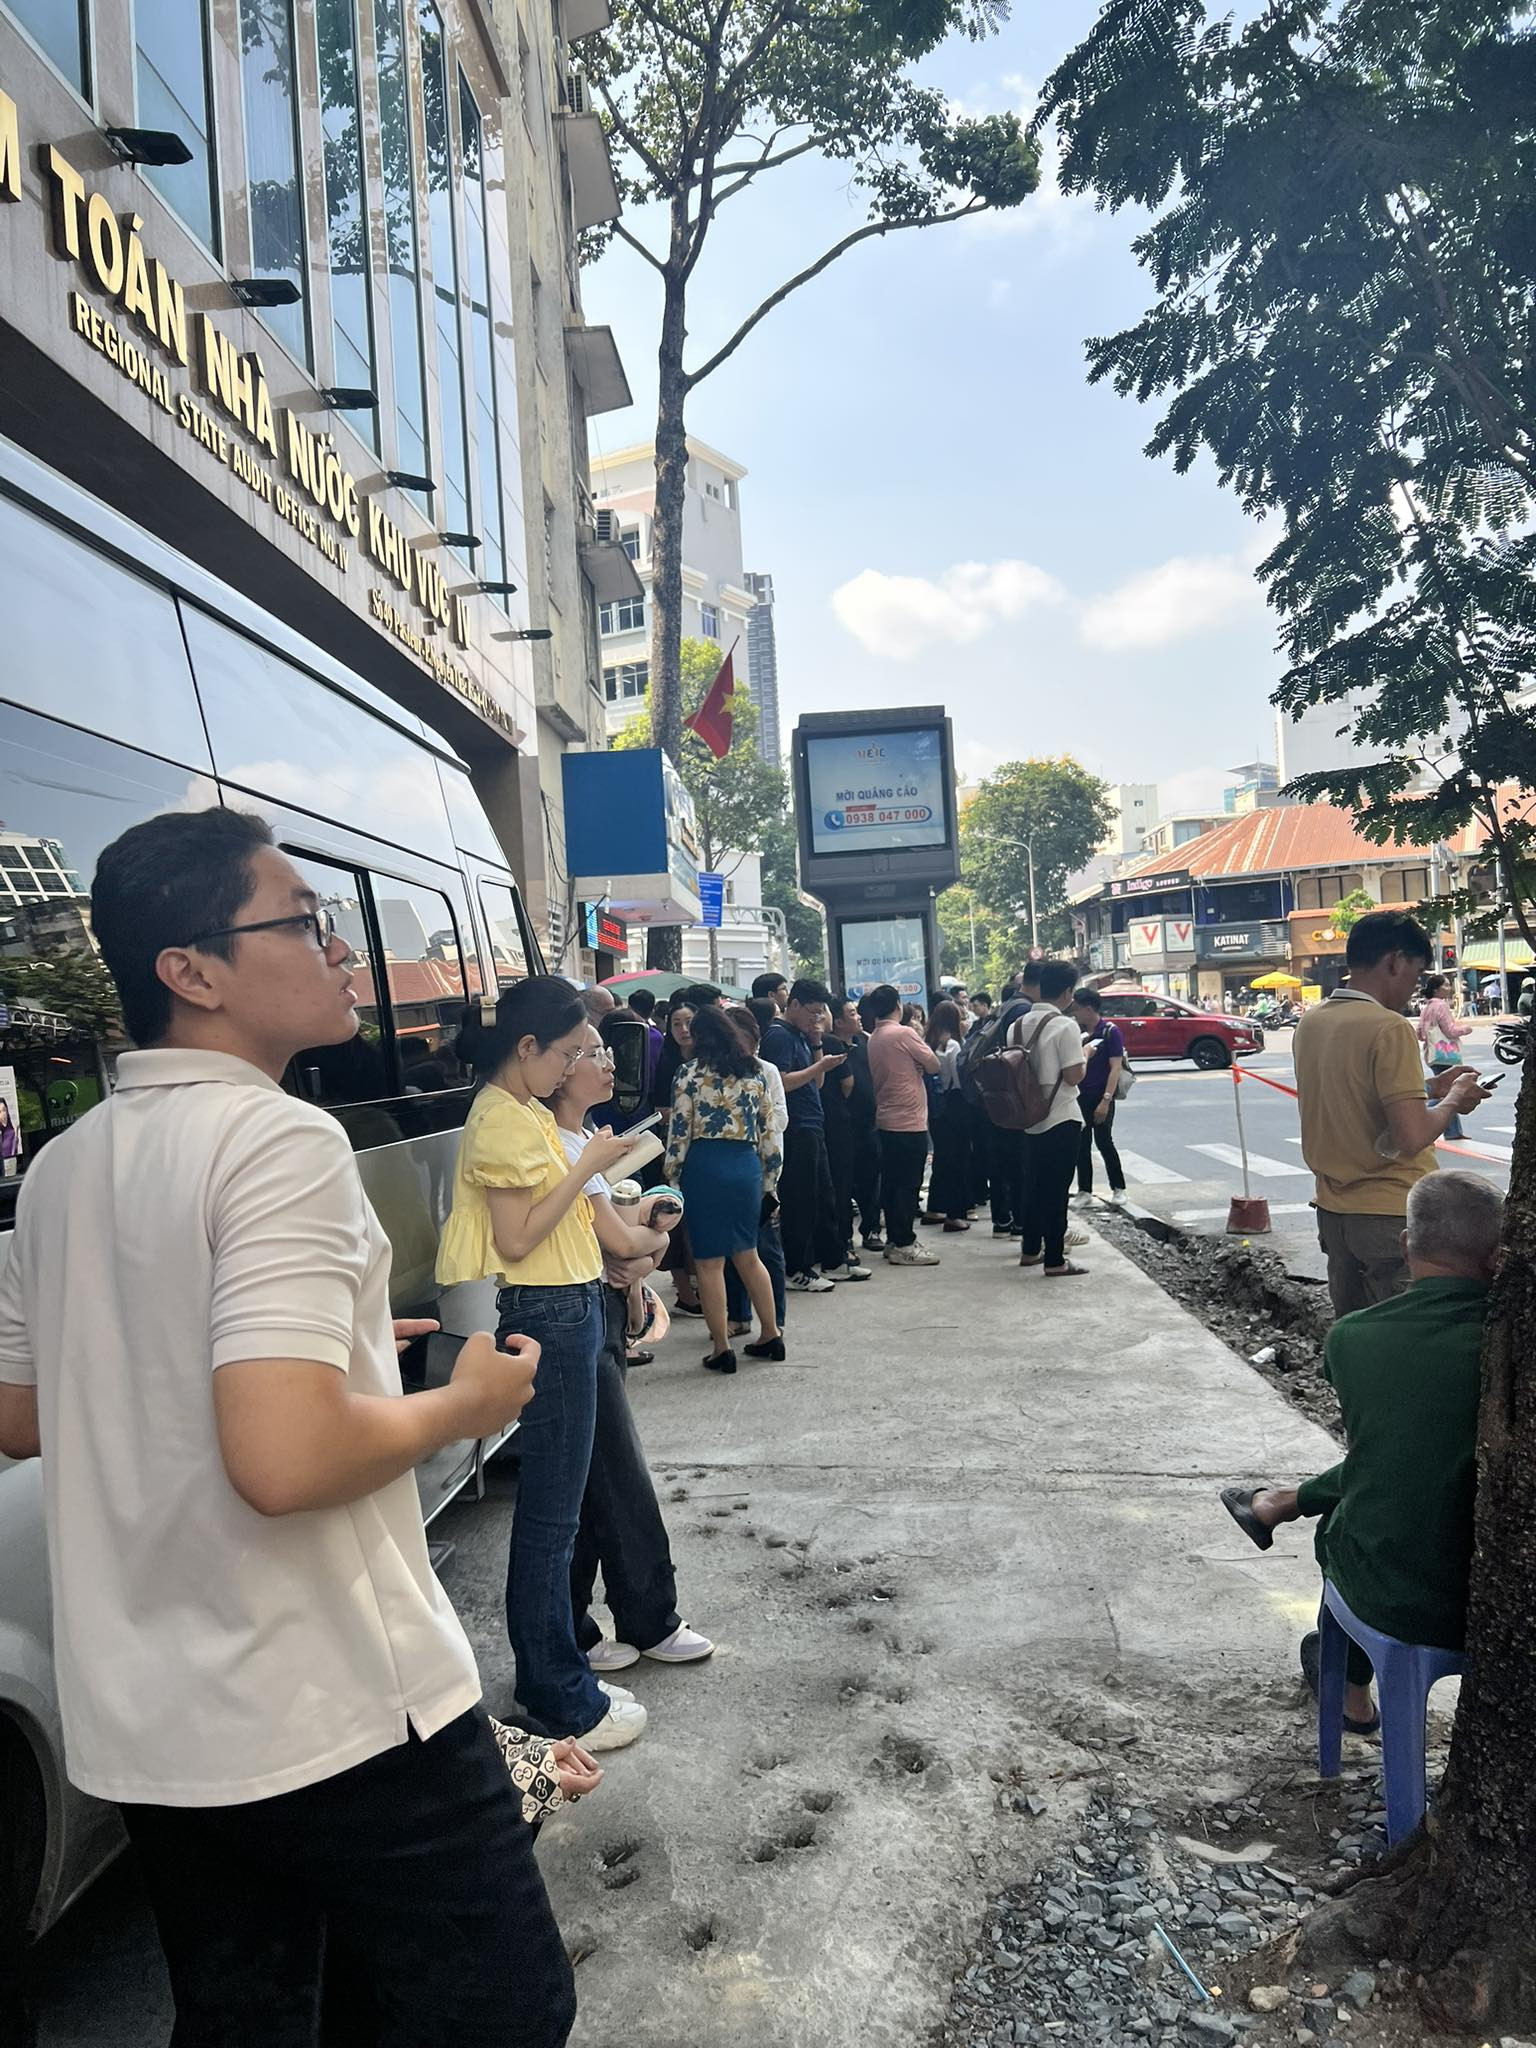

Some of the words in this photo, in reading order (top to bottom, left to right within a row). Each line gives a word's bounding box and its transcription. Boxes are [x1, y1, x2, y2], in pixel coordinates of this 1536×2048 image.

[50, 143, 188, 367] TOÁN
[204, 313, 278, 458] NHÀ
[287, 408, 361, 537] NƯỚC
[368, 496, 412, 591] KHU
[416, 549, 450, 636] VỰC
[456, 594, 471, 650] IV
[75, 291, 176, 416] REGIONAL
[179, 394, 229, 464] STATE
[233, 443, 273, 503] AUDIT
[276, 484, 317, 544] OFFICE
[846, 812, 874, 824] 0938
[879, 811, 900, 822] 047
[904, 809, 926, 820] 000
[1127, 878, 1152, 891] Indigo
[1214, 934, 1249, 948] KATINAT
